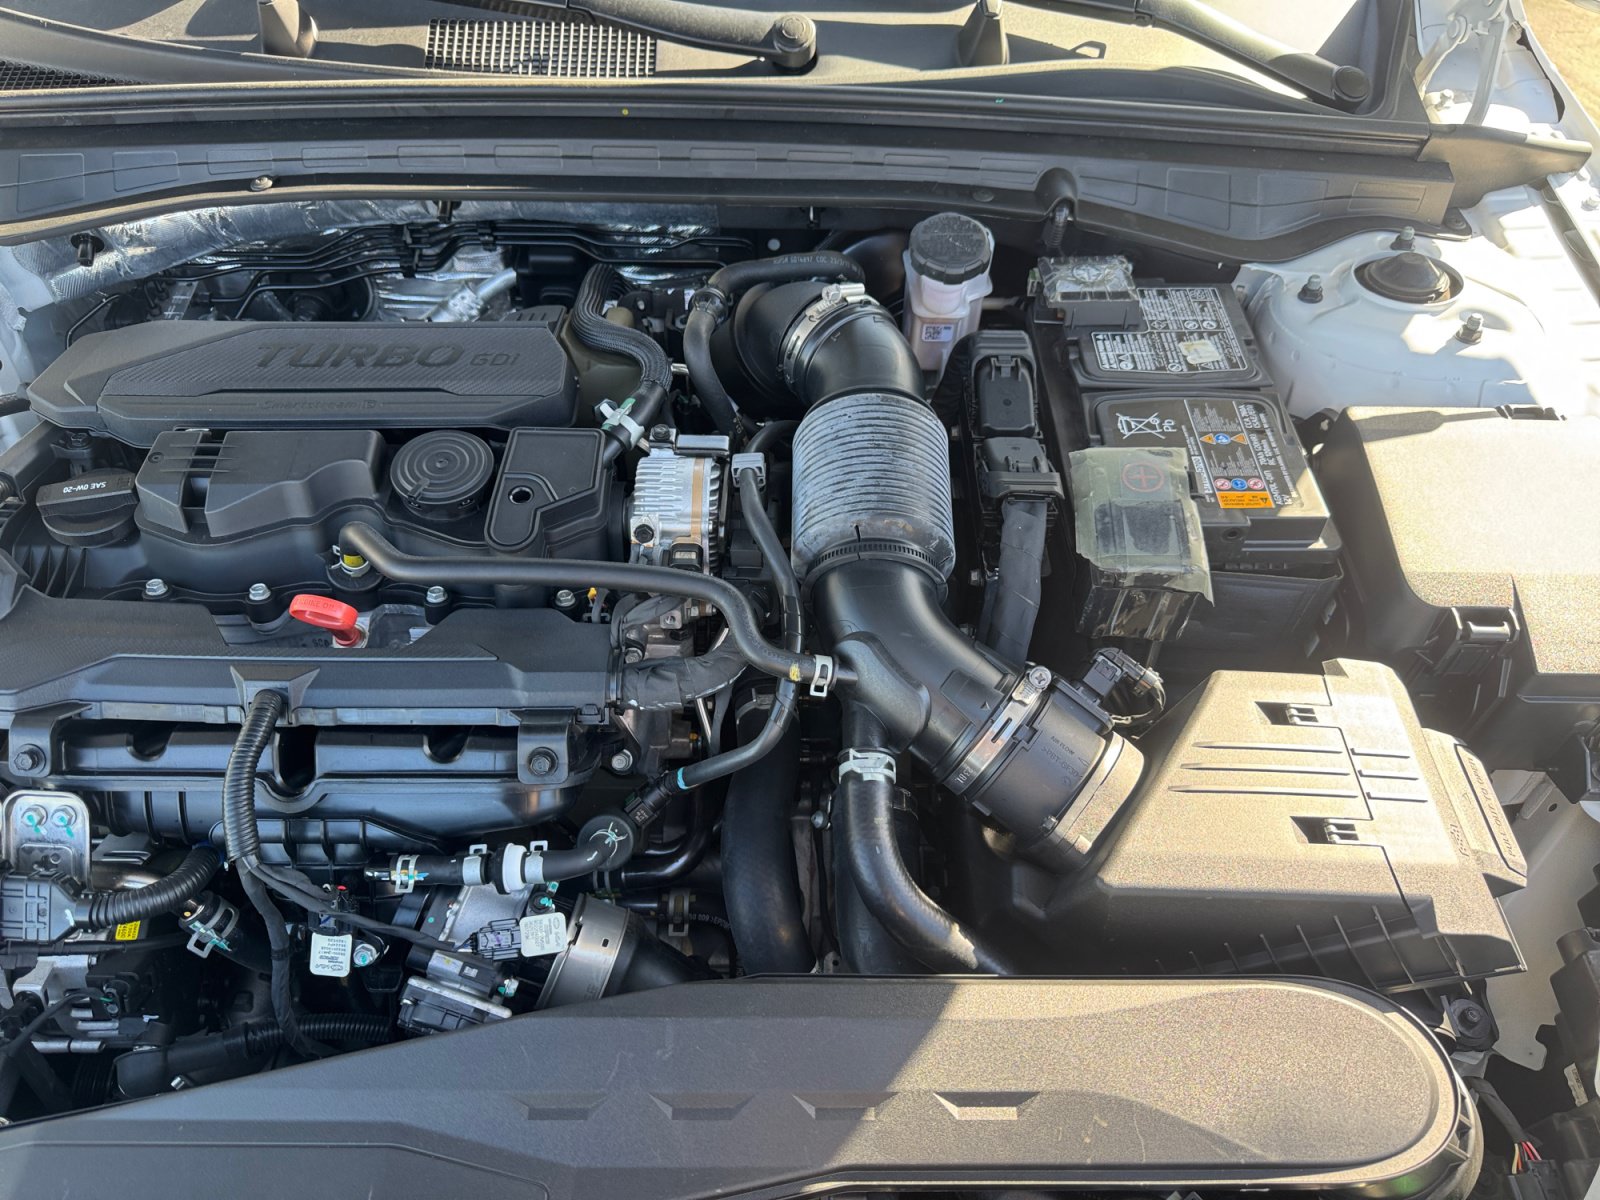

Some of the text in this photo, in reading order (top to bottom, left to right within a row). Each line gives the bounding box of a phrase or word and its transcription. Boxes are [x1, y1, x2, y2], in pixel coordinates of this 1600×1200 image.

[257, 343, 463, 368] TURBO
[1162, 419, 1177, 432] Pb
[63, 481, 107, 493] SAE 0W-20
